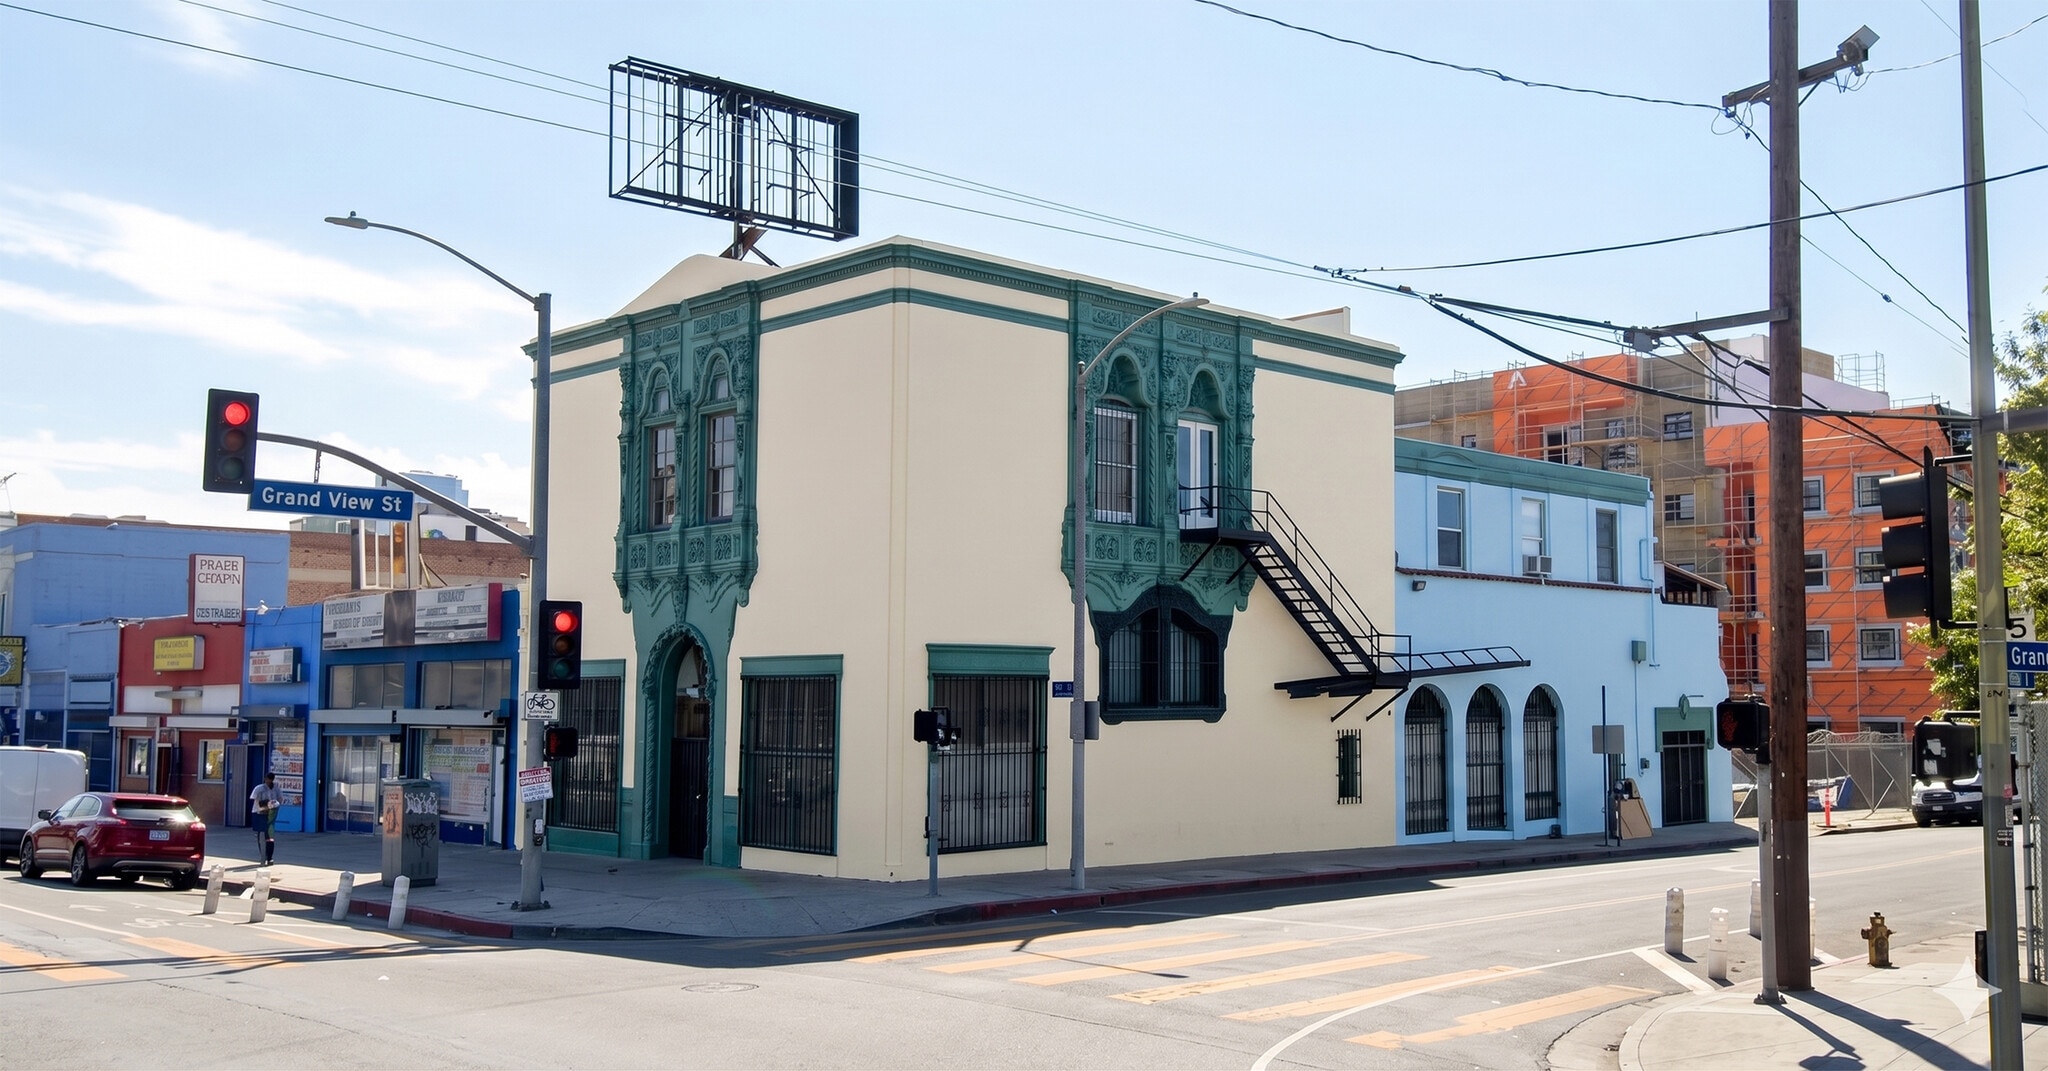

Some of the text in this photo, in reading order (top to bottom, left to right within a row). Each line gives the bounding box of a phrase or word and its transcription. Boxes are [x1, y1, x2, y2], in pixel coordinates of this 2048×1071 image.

[262, 487, 402, 513] Grand View St
